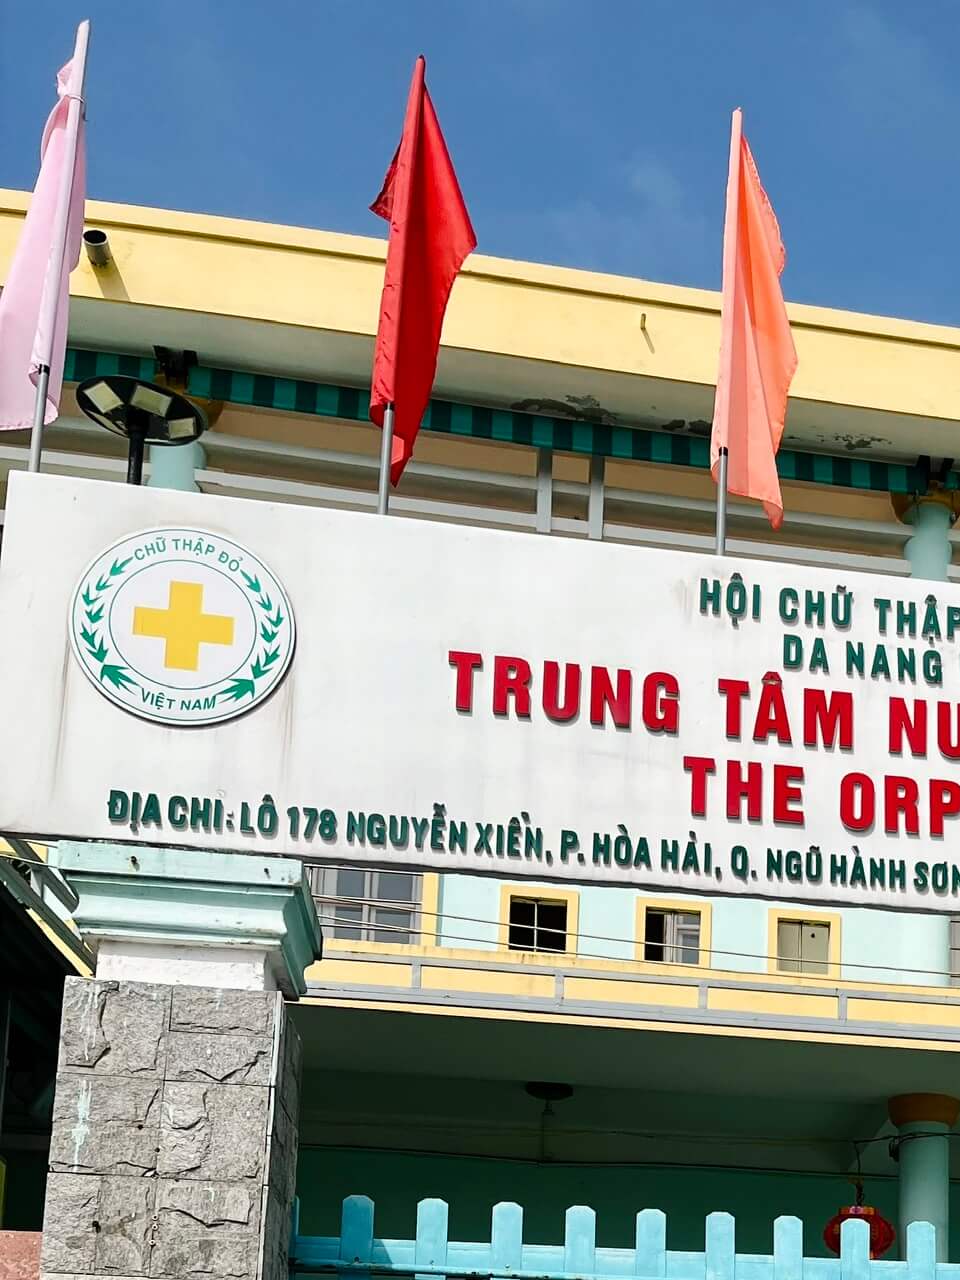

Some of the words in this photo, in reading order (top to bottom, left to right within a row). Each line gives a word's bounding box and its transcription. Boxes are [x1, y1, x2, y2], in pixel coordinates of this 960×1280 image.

[134, 537, 166, 561] CHỮ
[172, 537, 215, 556] THẬP
[218, 551, 243, 573] ĐỎ
[700, 573, 760, 626] HỘI
[780, 586, 852, 628] CHỮ
[784, 635, 828, 672] DA
[847, 641, 942, 684] NANG
[140, 688, 175, 711] VIỆT
[180, 695, 217, 711] NAM
[449, 651, 679, 734] TRUNG
[718, 672, 853, 750] TÂM
[684, 756, 804, 826] THE
[108, 790, 161, 831] ĐỊA
[240, 795, 277, 835] LÔ
[287, 807, 336, 841] 178
[593, 824, 651, 868] HÒA
[767, 846, 822, 882] NGŨ
[831, 846, 905, 889] HÀNH
